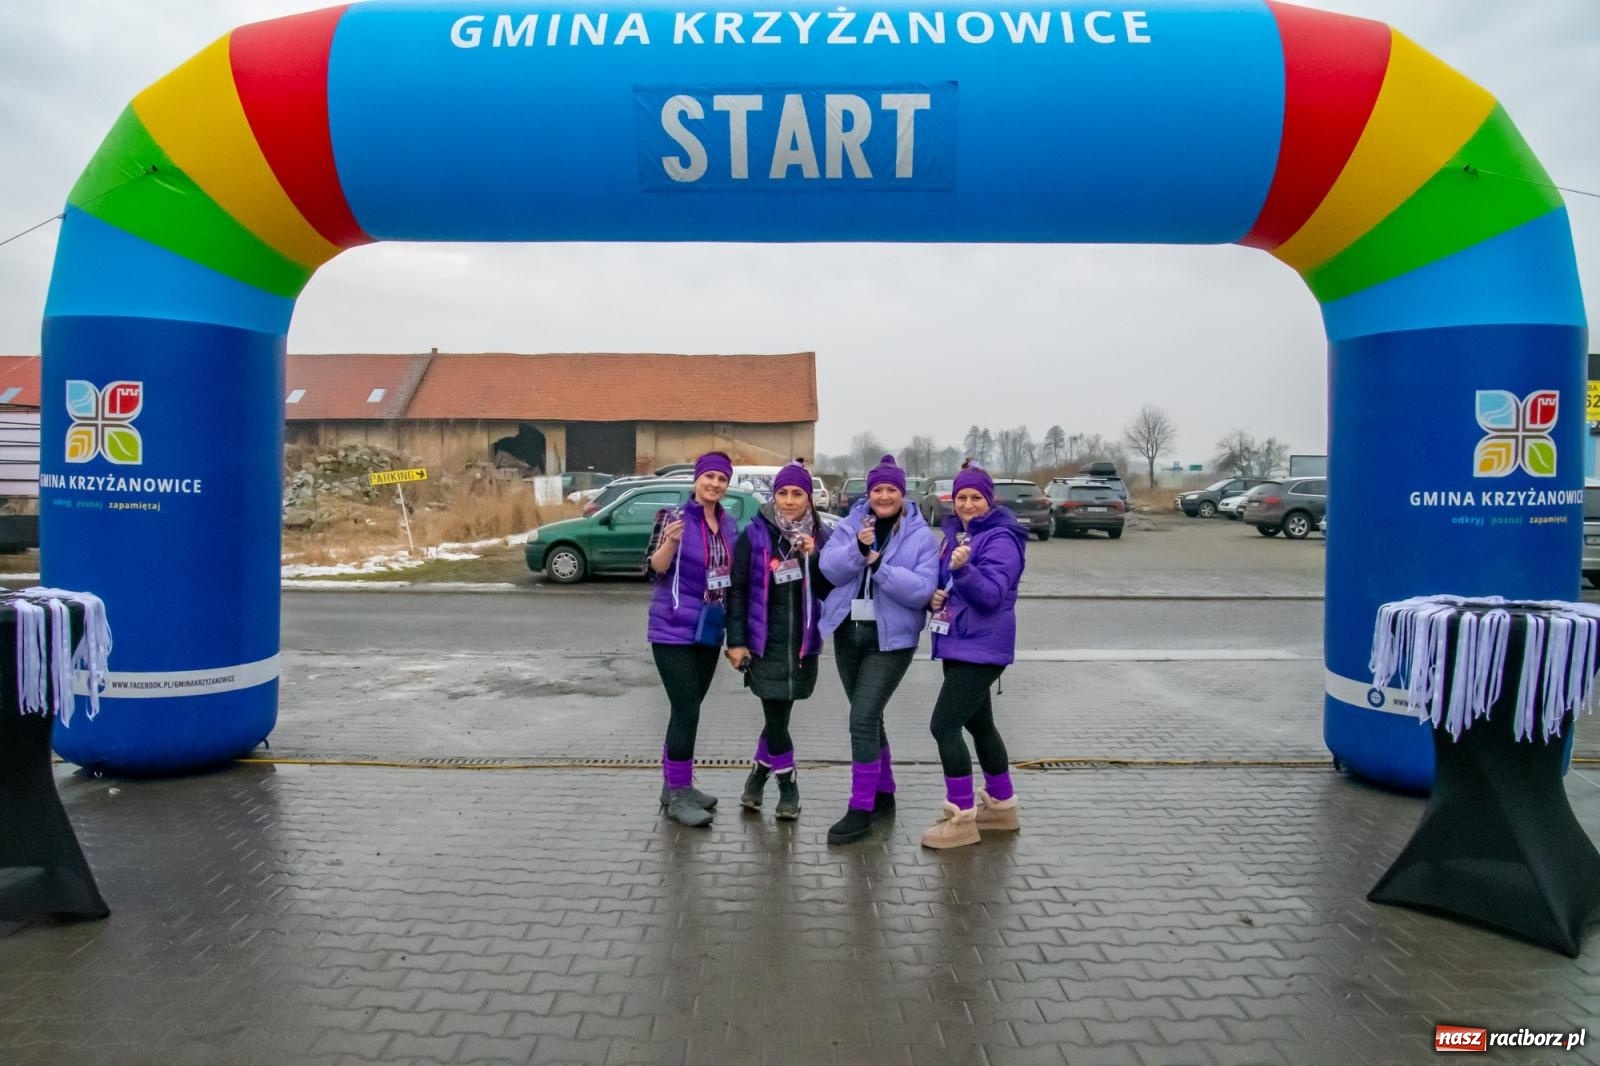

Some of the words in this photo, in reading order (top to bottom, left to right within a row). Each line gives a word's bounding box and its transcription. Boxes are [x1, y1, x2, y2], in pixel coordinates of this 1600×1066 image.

[449, 12, 651, 49] GMINA
[673, 6, 1152, 46] KRZYŻANOWICE
[660, 93, 931, 183] START
[40, 474, 66, 489] GMINA
[69, 474, 202, 493] KRZYŻANOWICE
[370, 471, 414, 484] PARKING
[108, 501, 161, 511] zapamiętaj
[1409, 491, 1476, 507] GMINA
[1481, 488, 1584, 506] KRZYŻANOWICE
[1451, 516, 1485, 526] odkryj
